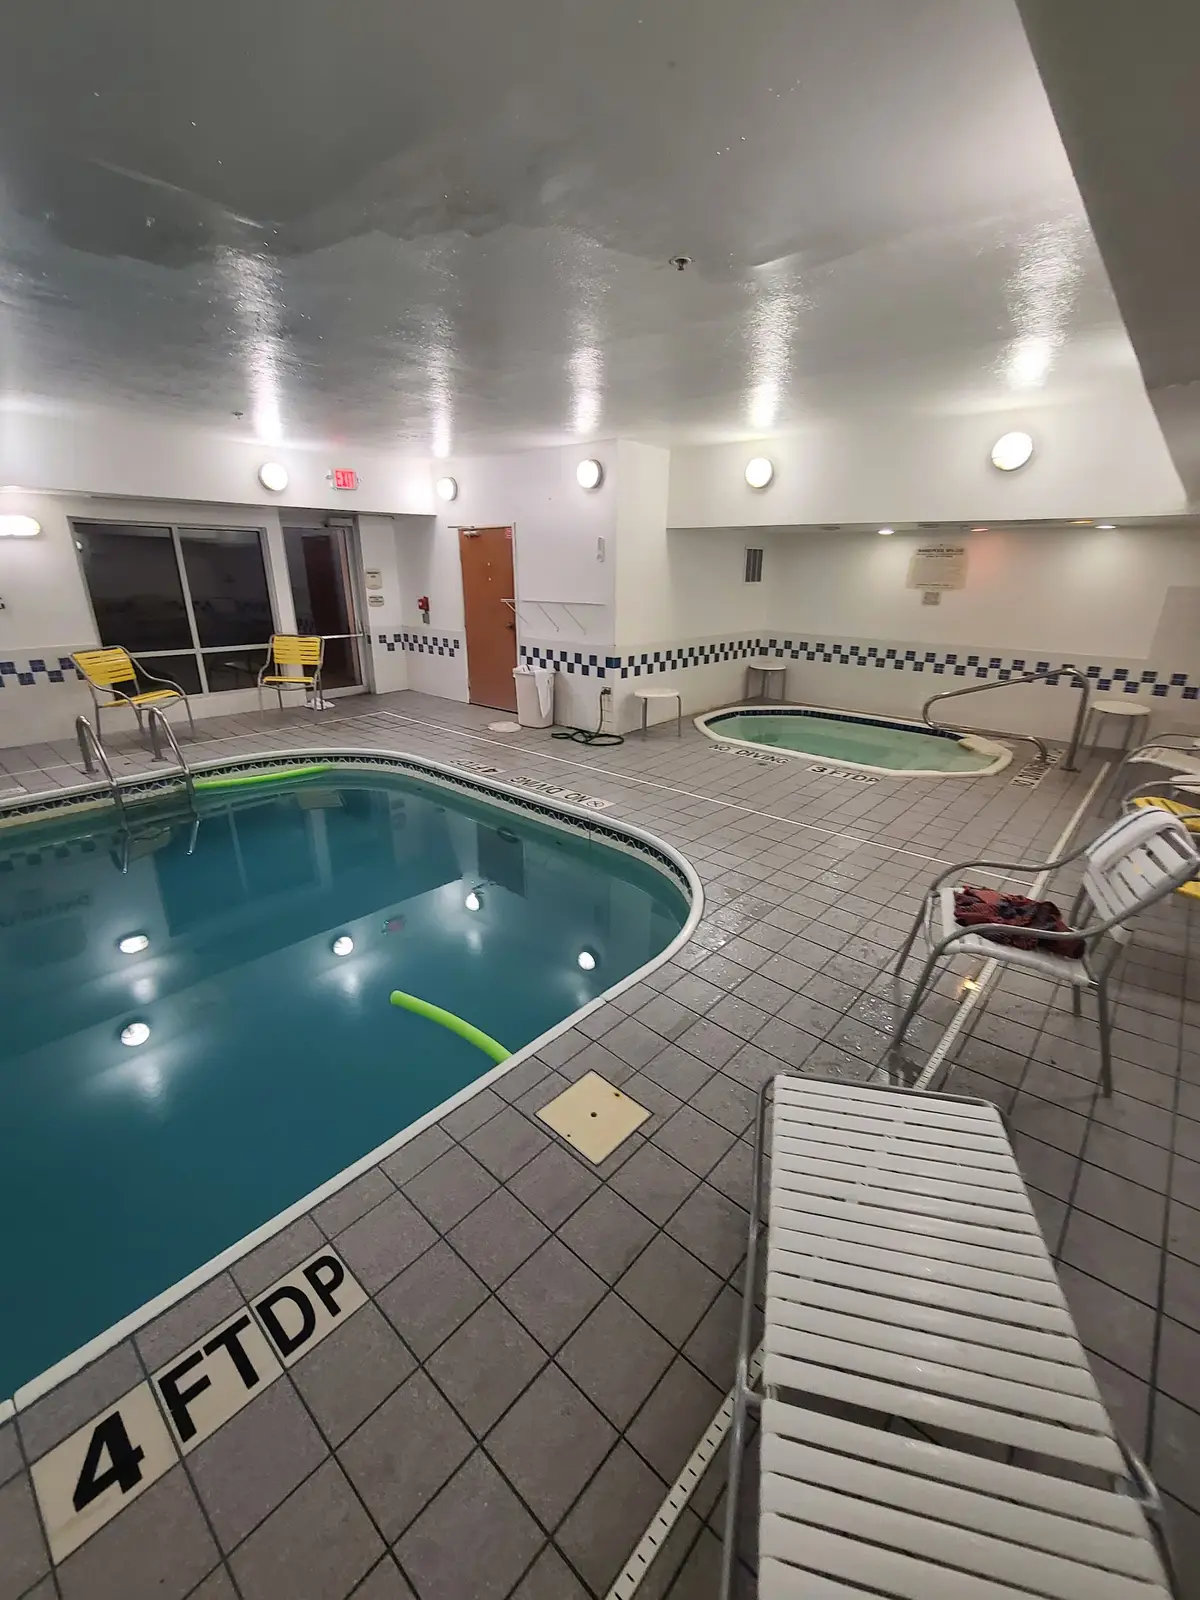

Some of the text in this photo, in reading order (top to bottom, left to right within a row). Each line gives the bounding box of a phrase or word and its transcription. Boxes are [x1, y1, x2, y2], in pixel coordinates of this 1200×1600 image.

[335, 470, 354, 488] EXIT
[735, 749, 789, 764] DIVING
[828, 770, 881, 783] FTDP
[510, 776, 592, 803] NO DIVING
[72, 1254, 345, 1513] 4 FTDP
